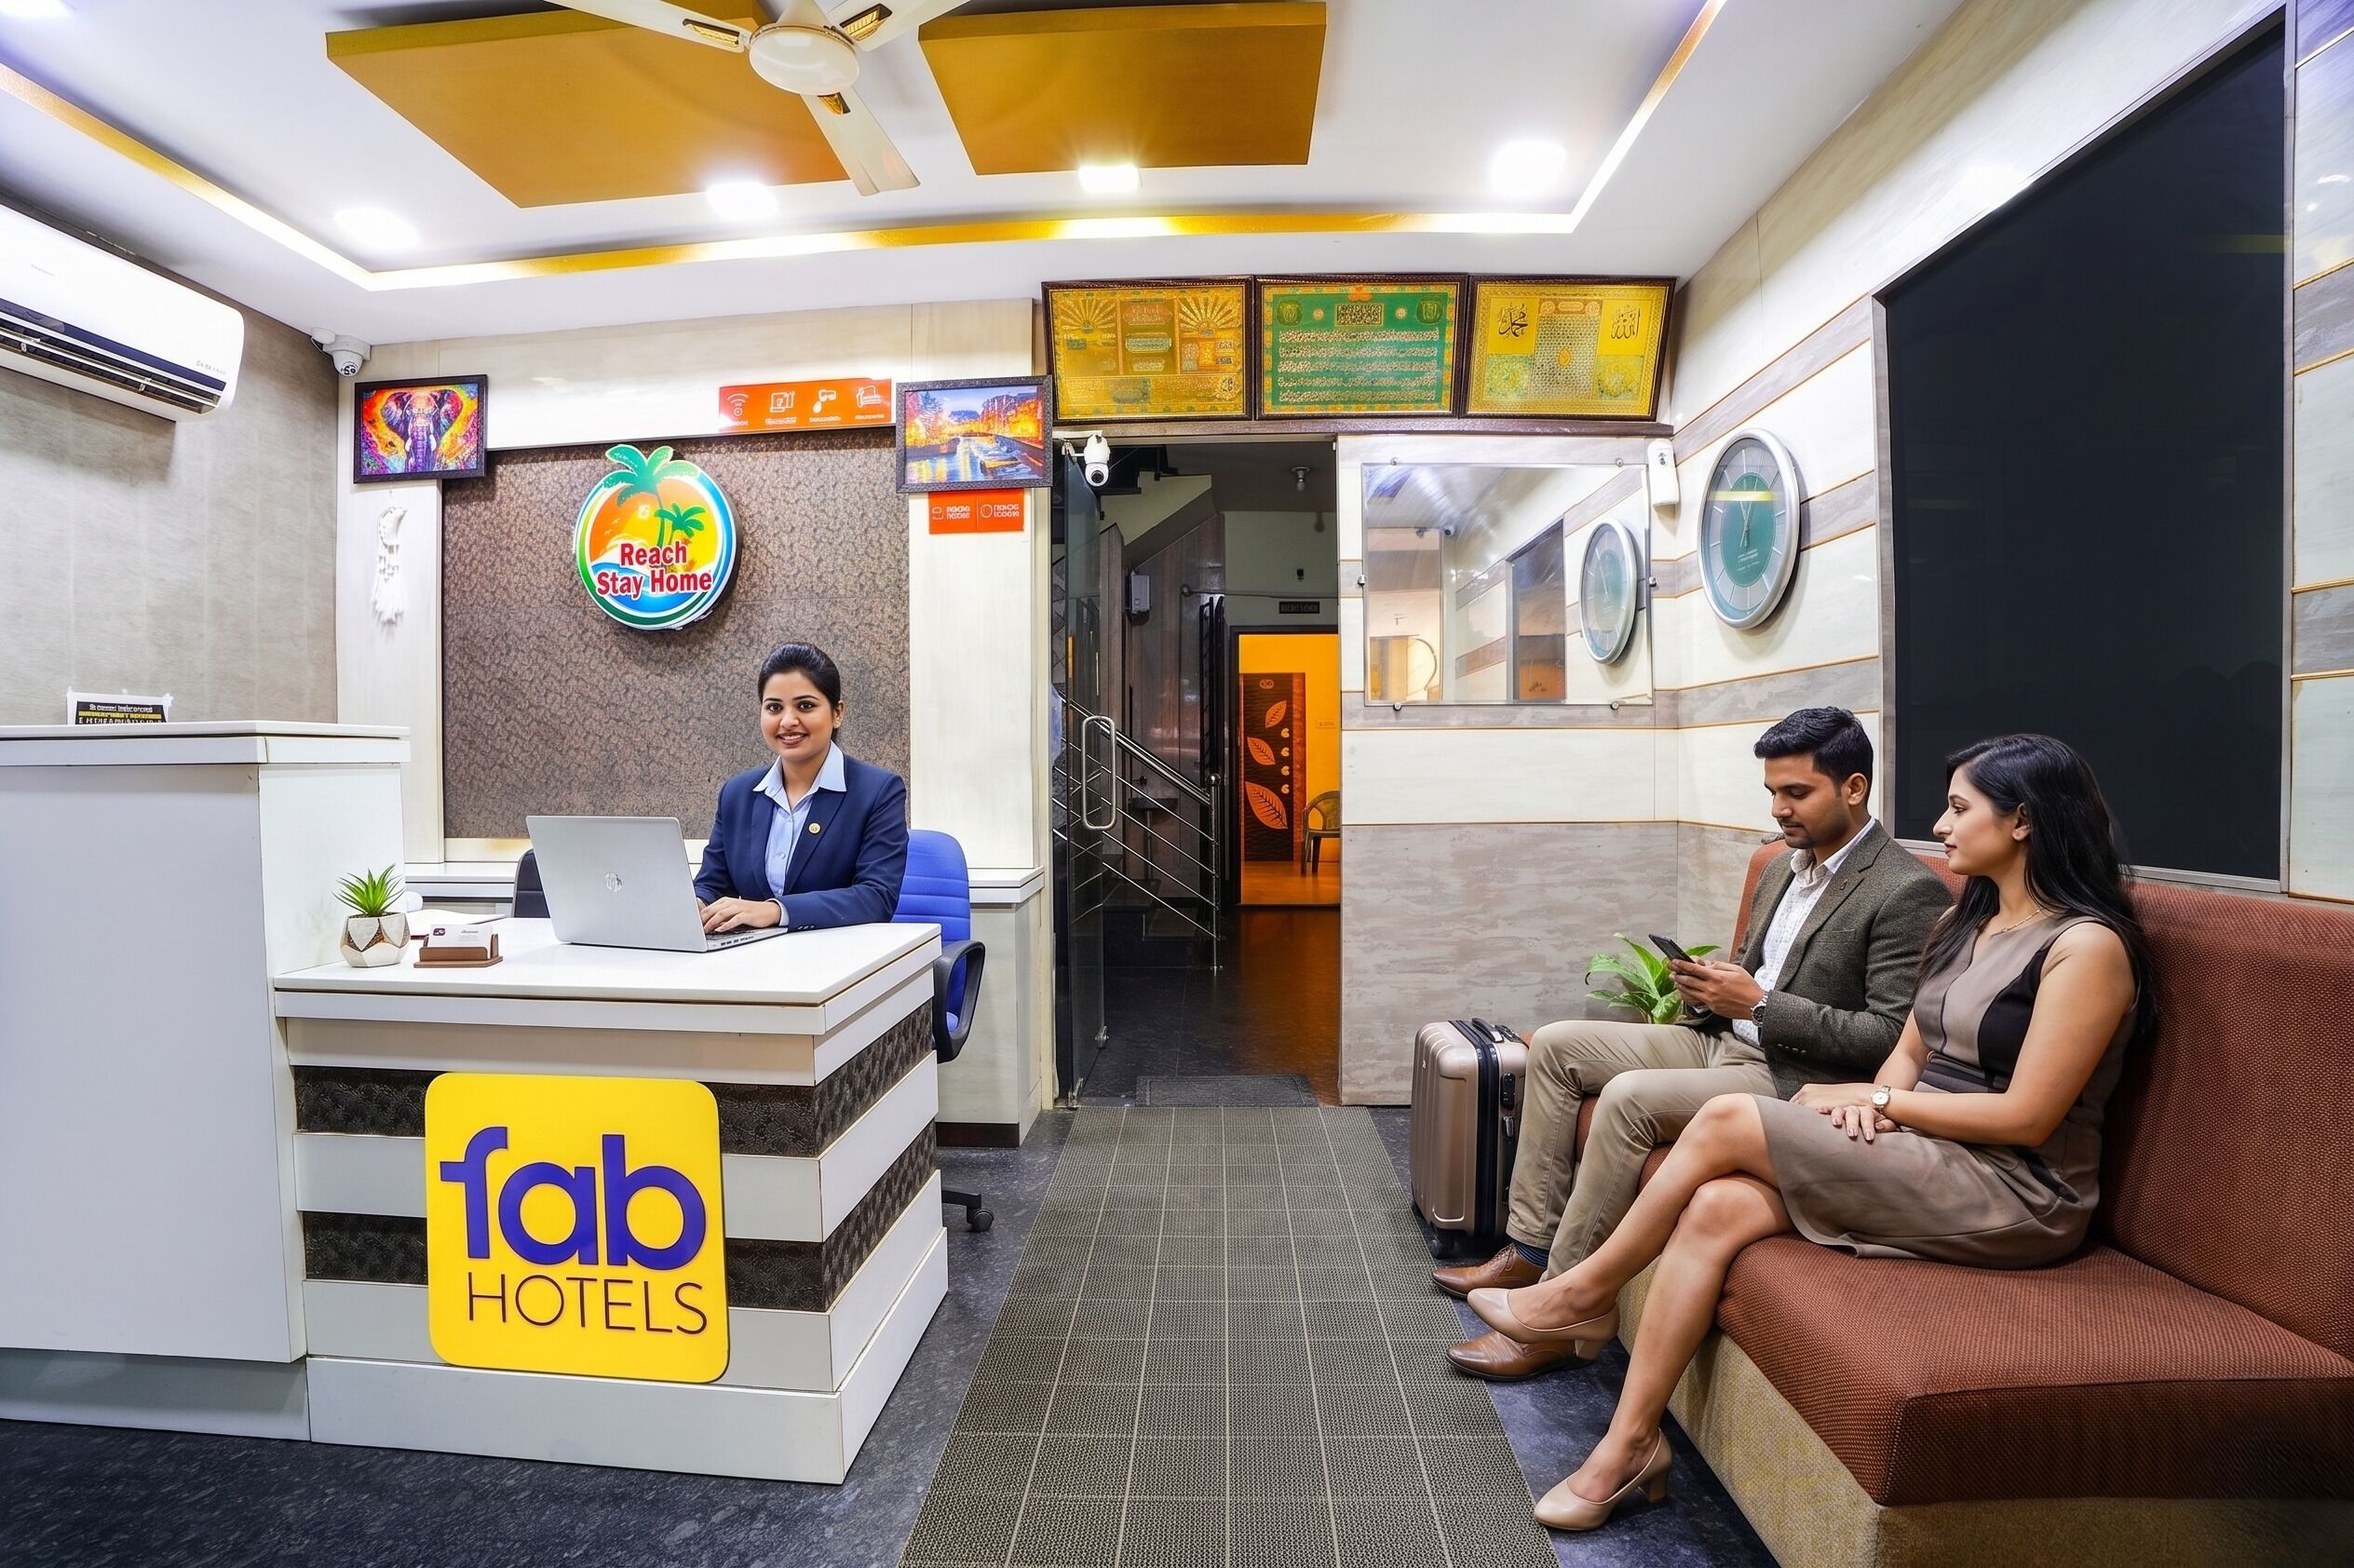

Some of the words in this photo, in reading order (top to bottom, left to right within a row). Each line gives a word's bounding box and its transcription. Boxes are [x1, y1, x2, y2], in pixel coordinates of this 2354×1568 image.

[620, 541, 687, 566] Reach
[597, 572, 643, 599] Stay
[651, 570, 712, 593] Home
[440, 1127, 707, 1270] fab
[467, 1271, 708, 1335] HOTELS
